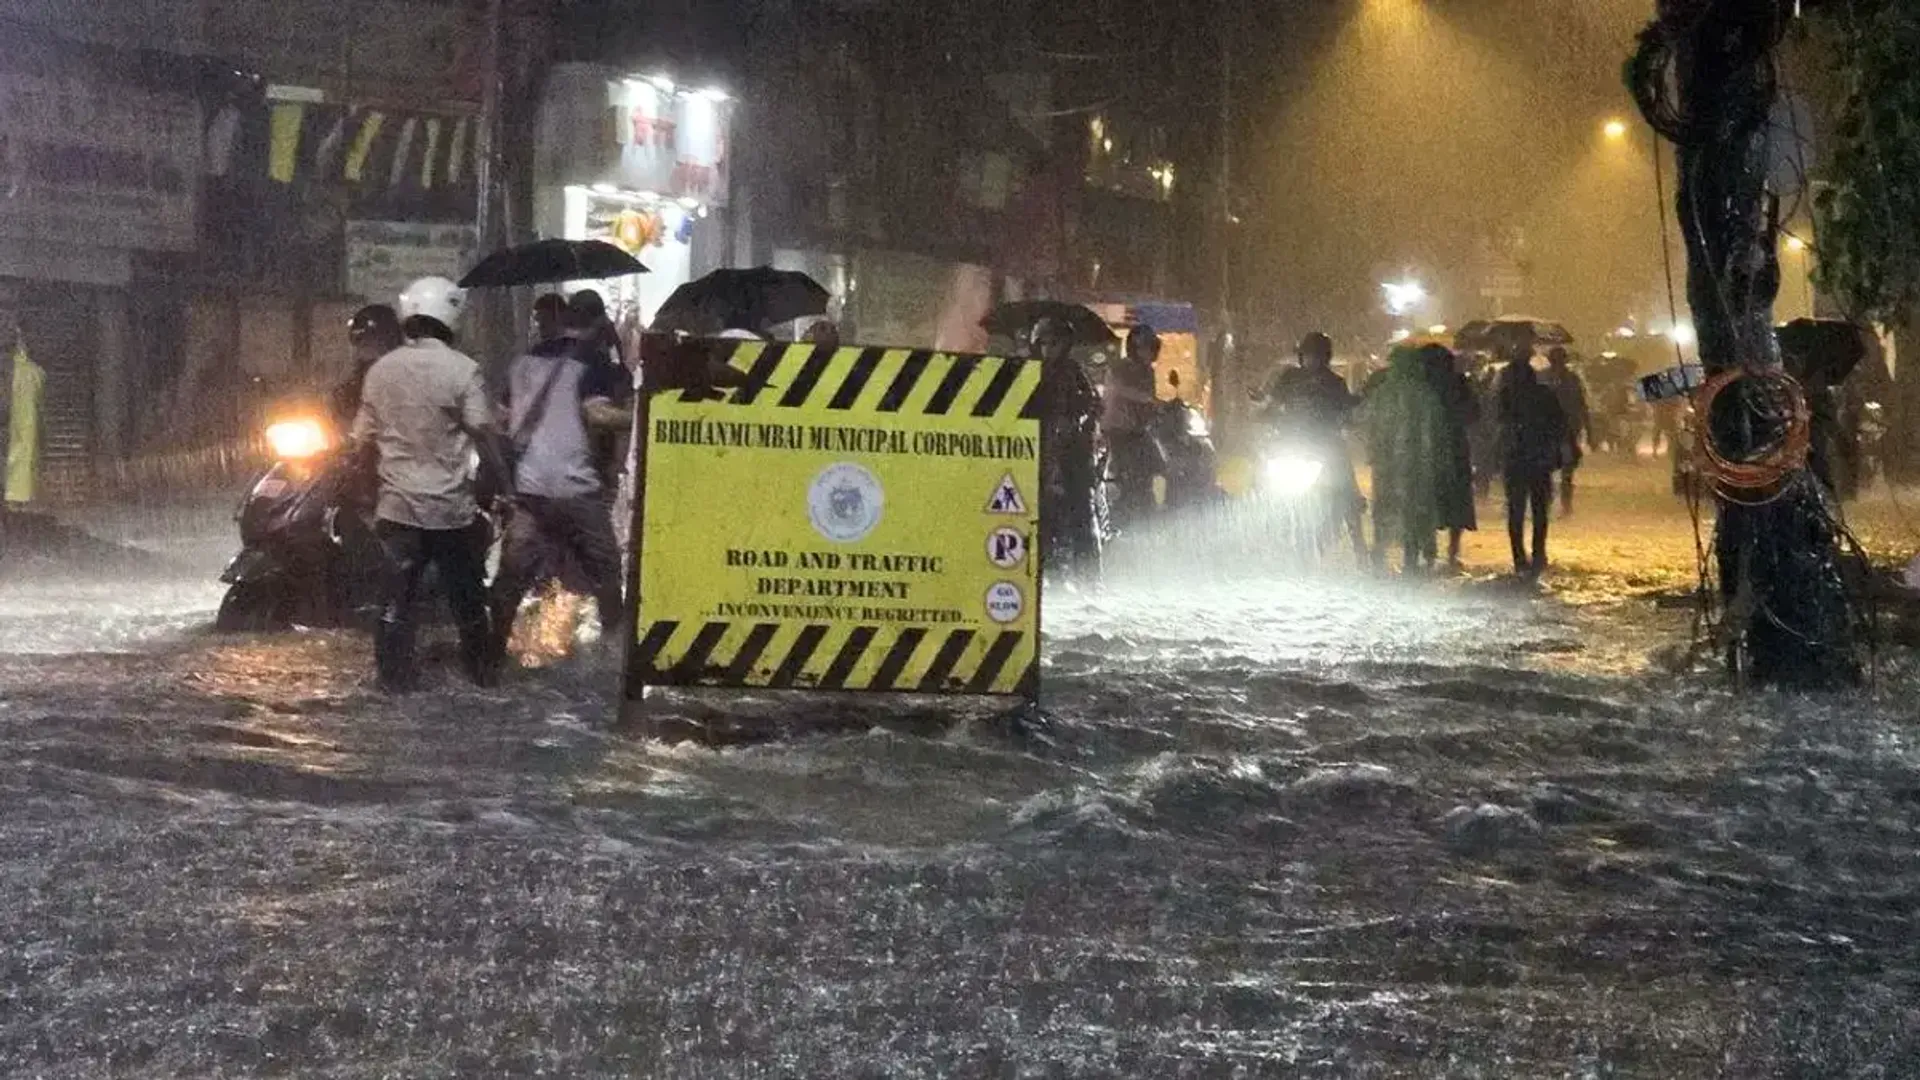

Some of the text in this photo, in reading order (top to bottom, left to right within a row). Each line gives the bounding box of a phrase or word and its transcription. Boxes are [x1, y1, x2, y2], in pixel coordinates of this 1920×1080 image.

[655, 419, 1036, 460] BRIHANMUMBAI MUNICIPAL CORPORATION
[726, 550, 943, 573] ROAD AND TRAFFIC
[757, 578, 910, 599] DEPARTMENT
